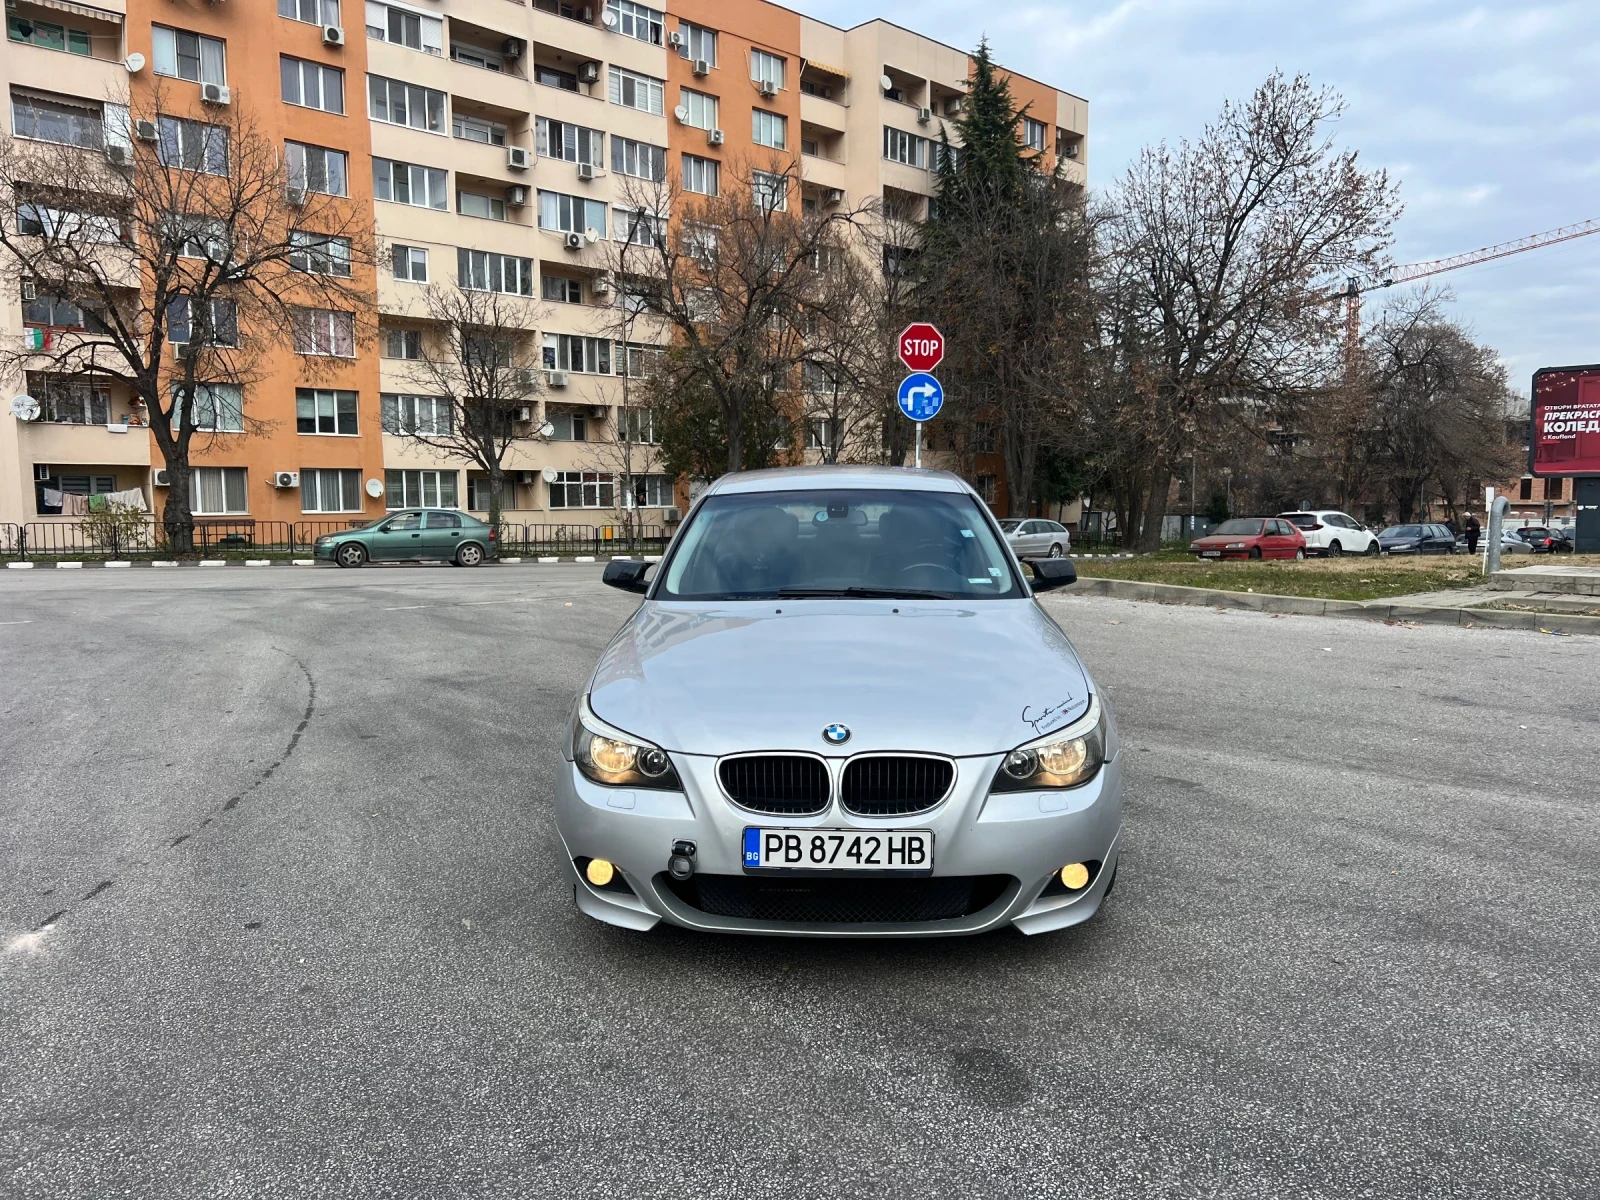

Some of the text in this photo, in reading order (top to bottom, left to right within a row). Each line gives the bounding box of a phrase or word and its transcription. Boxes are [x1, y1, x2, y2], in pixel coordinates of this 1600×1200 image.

[904, 339, 939, 356] STOP
[1544, 421, 1600, 433] КОЛЕД
[746, 852, 759, 861] BG
[765, 834, 926, 865] PB 8742 HB
